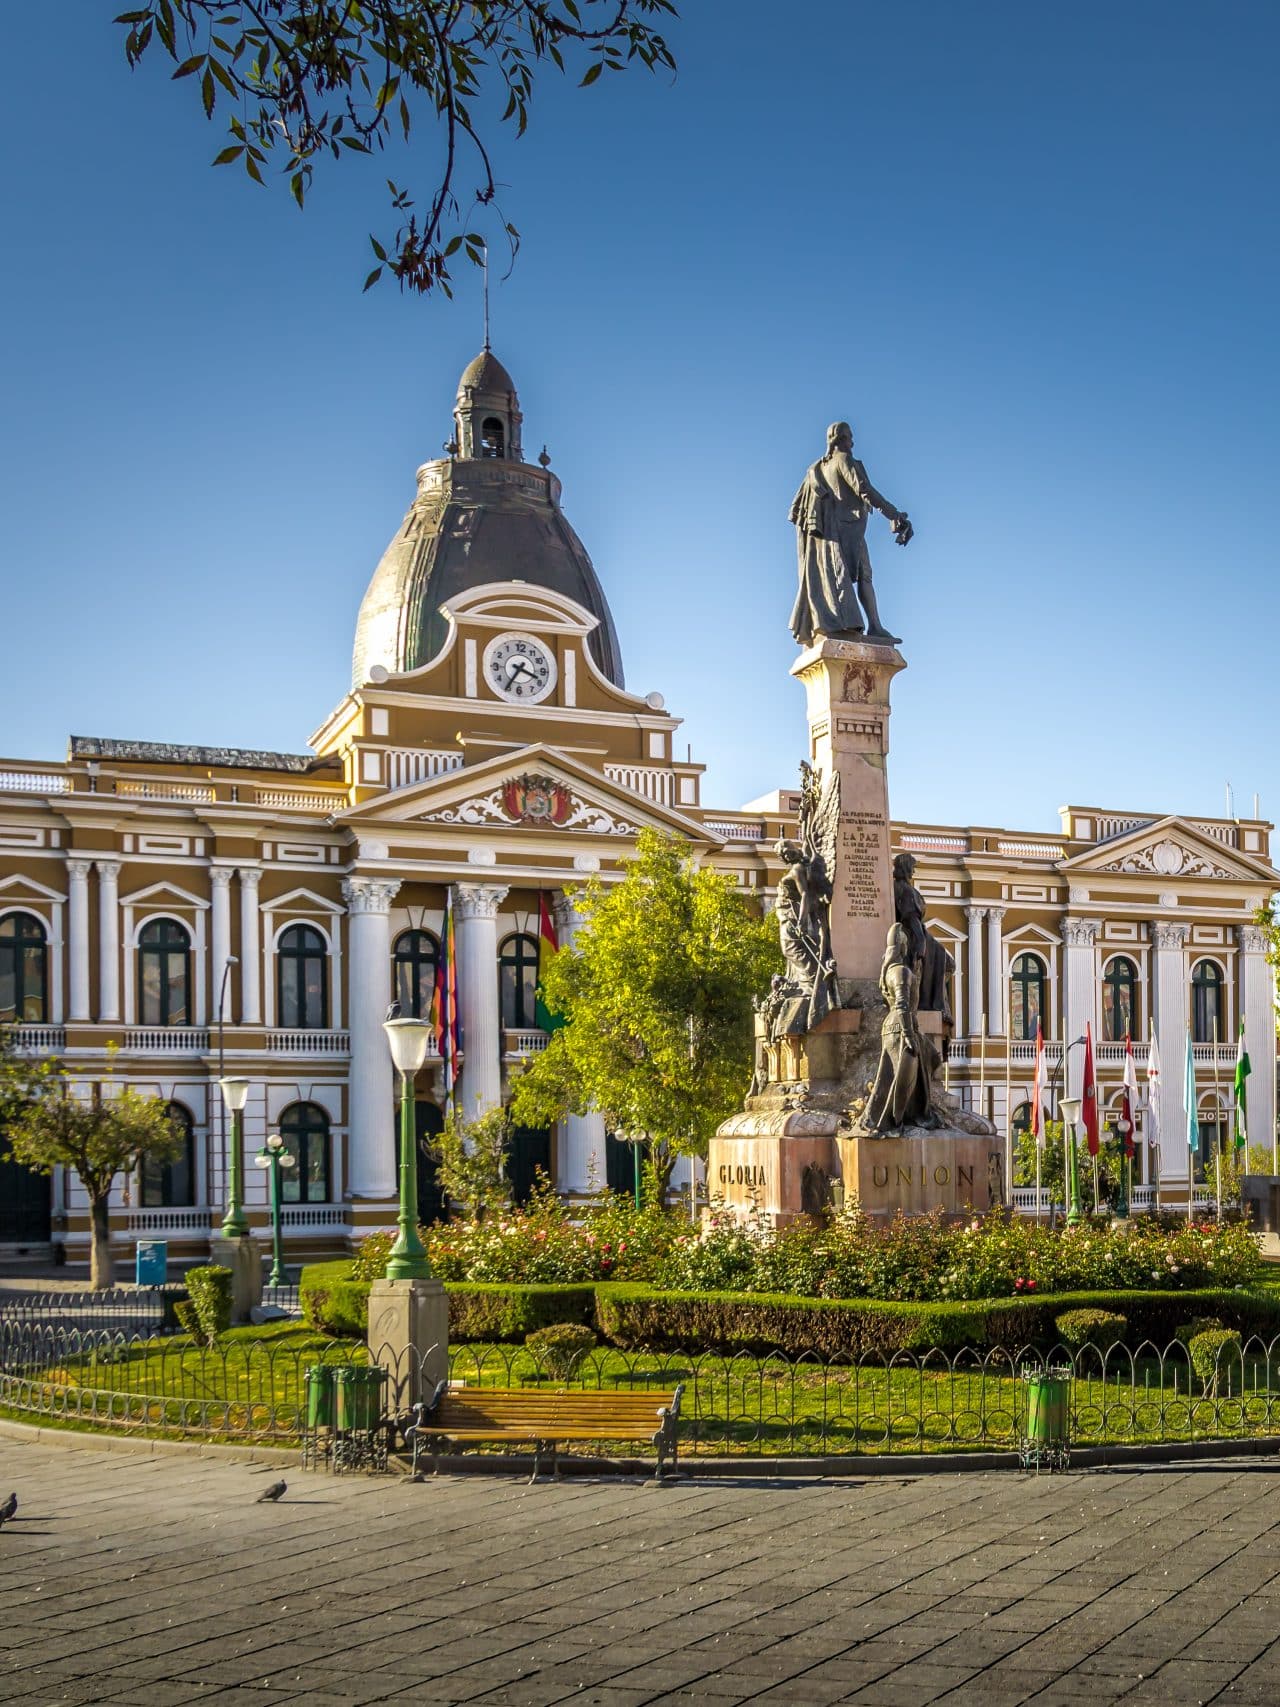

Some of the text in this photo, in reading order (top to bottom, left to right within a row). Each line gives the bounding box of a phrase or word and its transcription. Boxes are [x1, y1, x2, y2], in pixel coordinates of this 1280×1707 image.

[515, 643, 526, 653] 12
[492, 662, 499, 671] 3
[843, 831, 879, 842] LA PAZ
[719, 1164, 767, 1186] GLORIA
[872, 1165, 975, 1188] UNION
